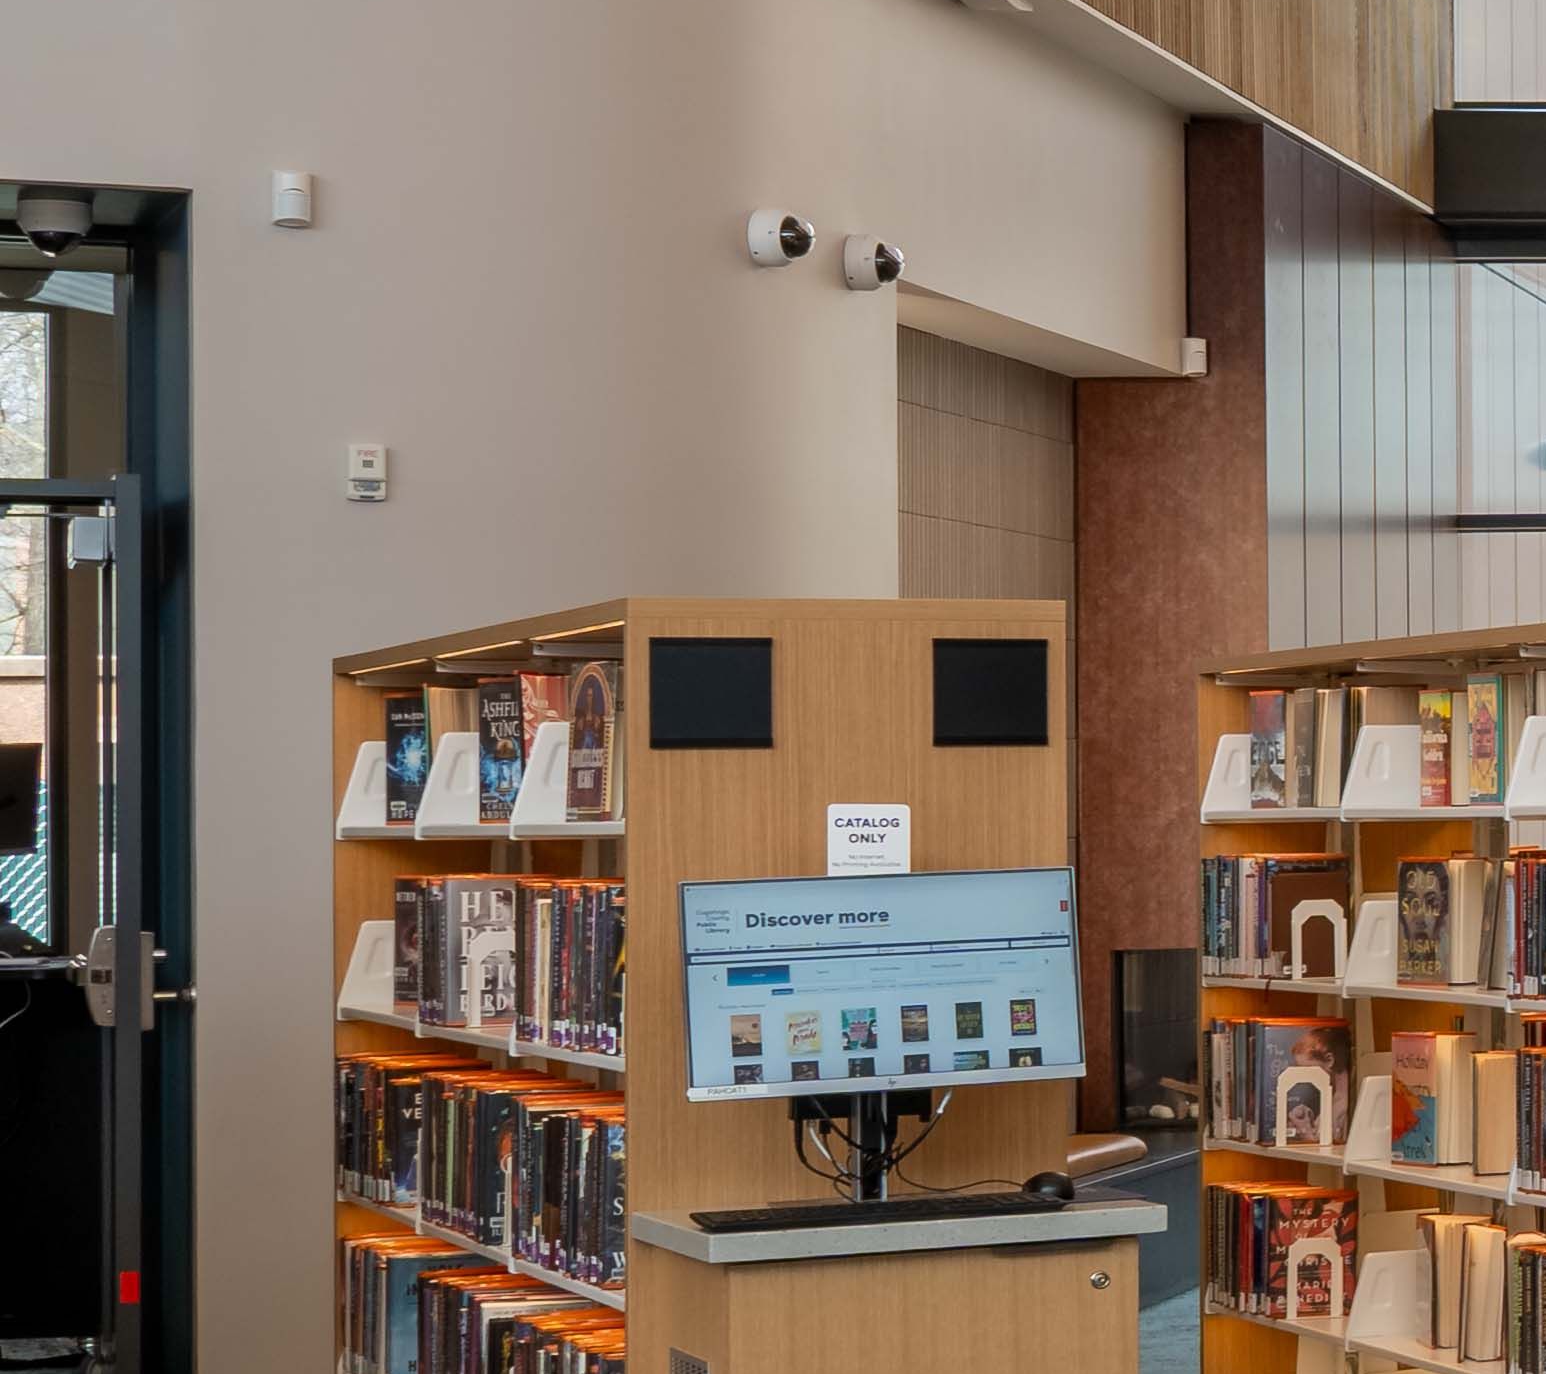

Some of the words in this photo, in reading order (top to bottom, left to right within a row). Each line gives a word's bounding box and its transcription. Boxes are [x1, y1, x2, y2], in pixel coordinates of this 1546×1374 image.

[834, 818, 900, 828] CATALOG
[849, 834, 886, 843] ONLY
[1402, 898, 1440, 916] SOUL
[746, 913, 833, 928] Discover
[839, 910, 889, 923] more
[1401, 938, 1439, 954] SUSAN
[1292, 1208, 1313, 1216] THE
[1279, 1217, 1350, 1229] MYSTERY
